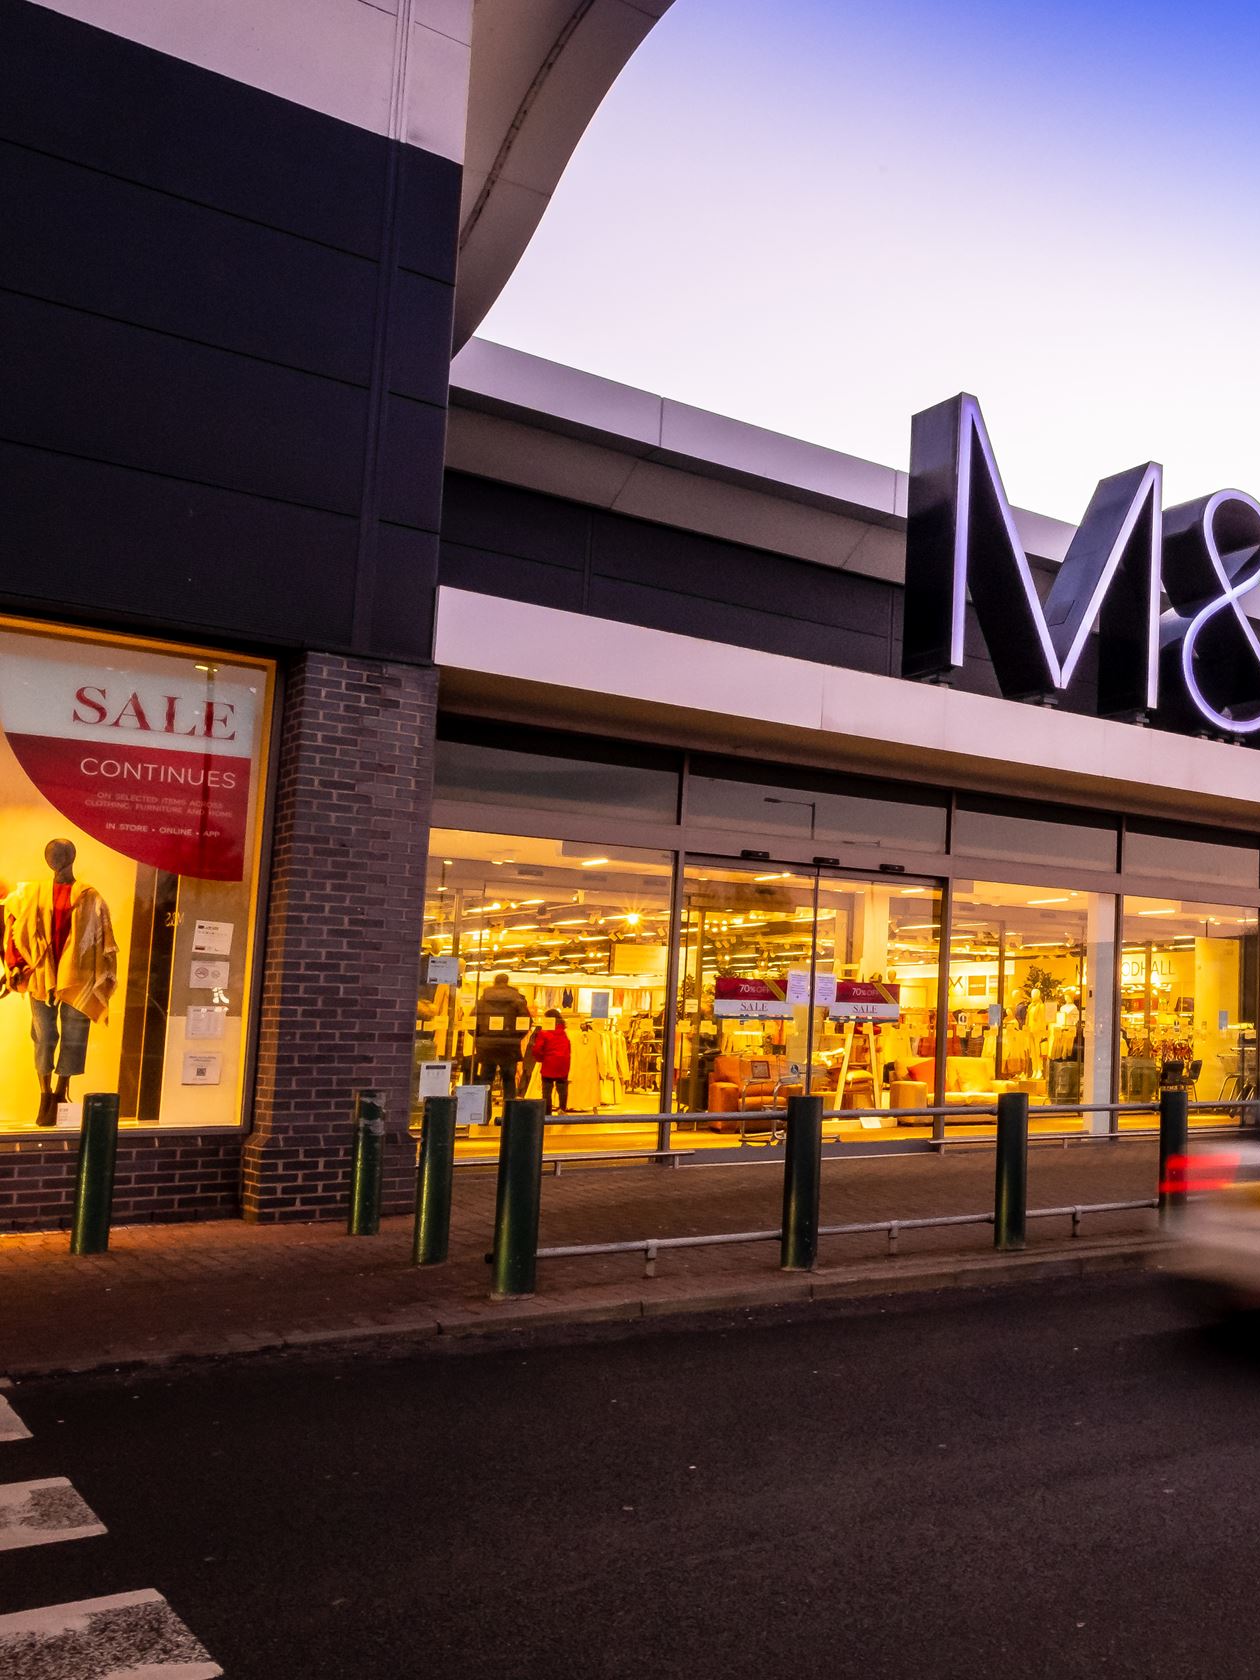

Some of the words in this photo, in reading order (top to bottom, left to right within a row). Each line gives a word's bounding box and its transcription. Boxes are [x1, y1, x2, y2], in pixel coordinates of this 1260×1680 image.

[72, 686, 236, 741] SALE
[80, 757, 237, 789] CONTINUES
[97, 791, 112, 800] ON
[115, 792, 158, 804] SELECTED
[161, 797, 187, 807] ITEMS
[135, 803, 183, 815] FURNITURE
[187, 808, 205, 817] AND
[208, 807, 233, 818] HOME
[105, 822, 116, 830] IN
[119, 823, 149, 833] STORE
[159, 826, 193, 837] ONLINE
[203, 830, 221, 838] APP
[1121, 959, 1176, 977] ODHALL
[740, 1001, 769, 1012] SALE
[852, 1004, 878, 1014] SALE
